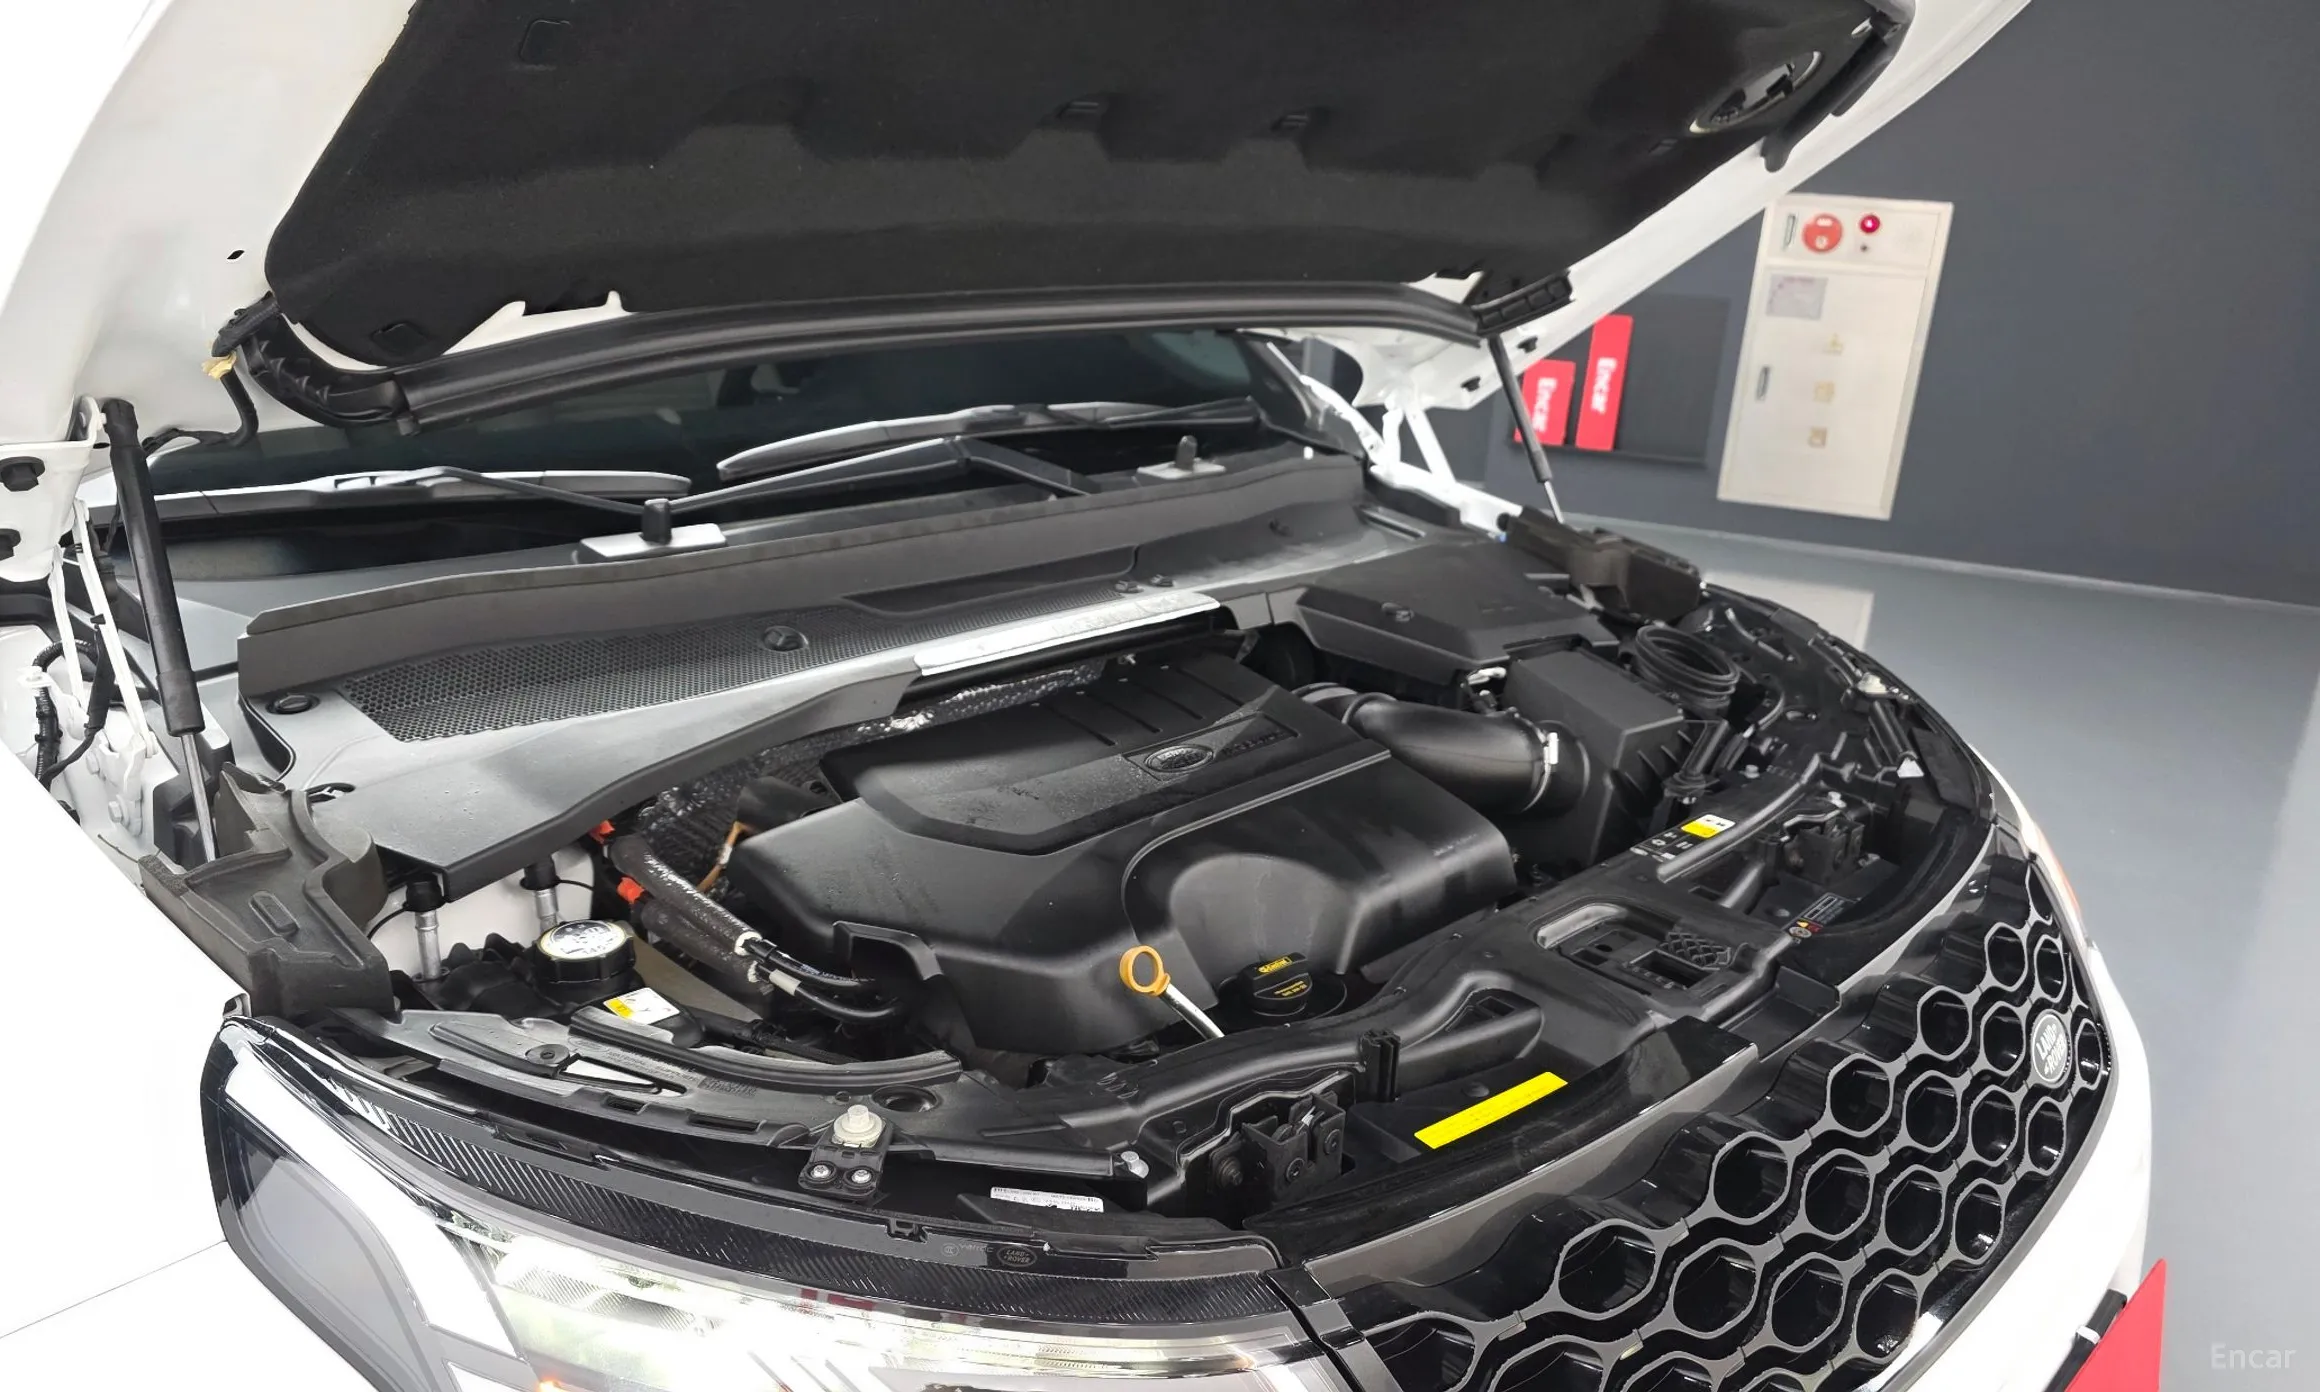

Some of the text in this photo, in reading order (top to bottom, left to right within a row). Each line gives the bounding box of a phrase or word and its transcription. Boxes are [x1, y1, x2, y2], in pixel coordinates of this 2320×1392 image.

[1531, 377, 1557, 433] Encar
[1590, 357, 1617, 414] Encar
[2036, 1024, 2057, 1060] LAND
[2046, 1034, 2066, 1075] ROVER
